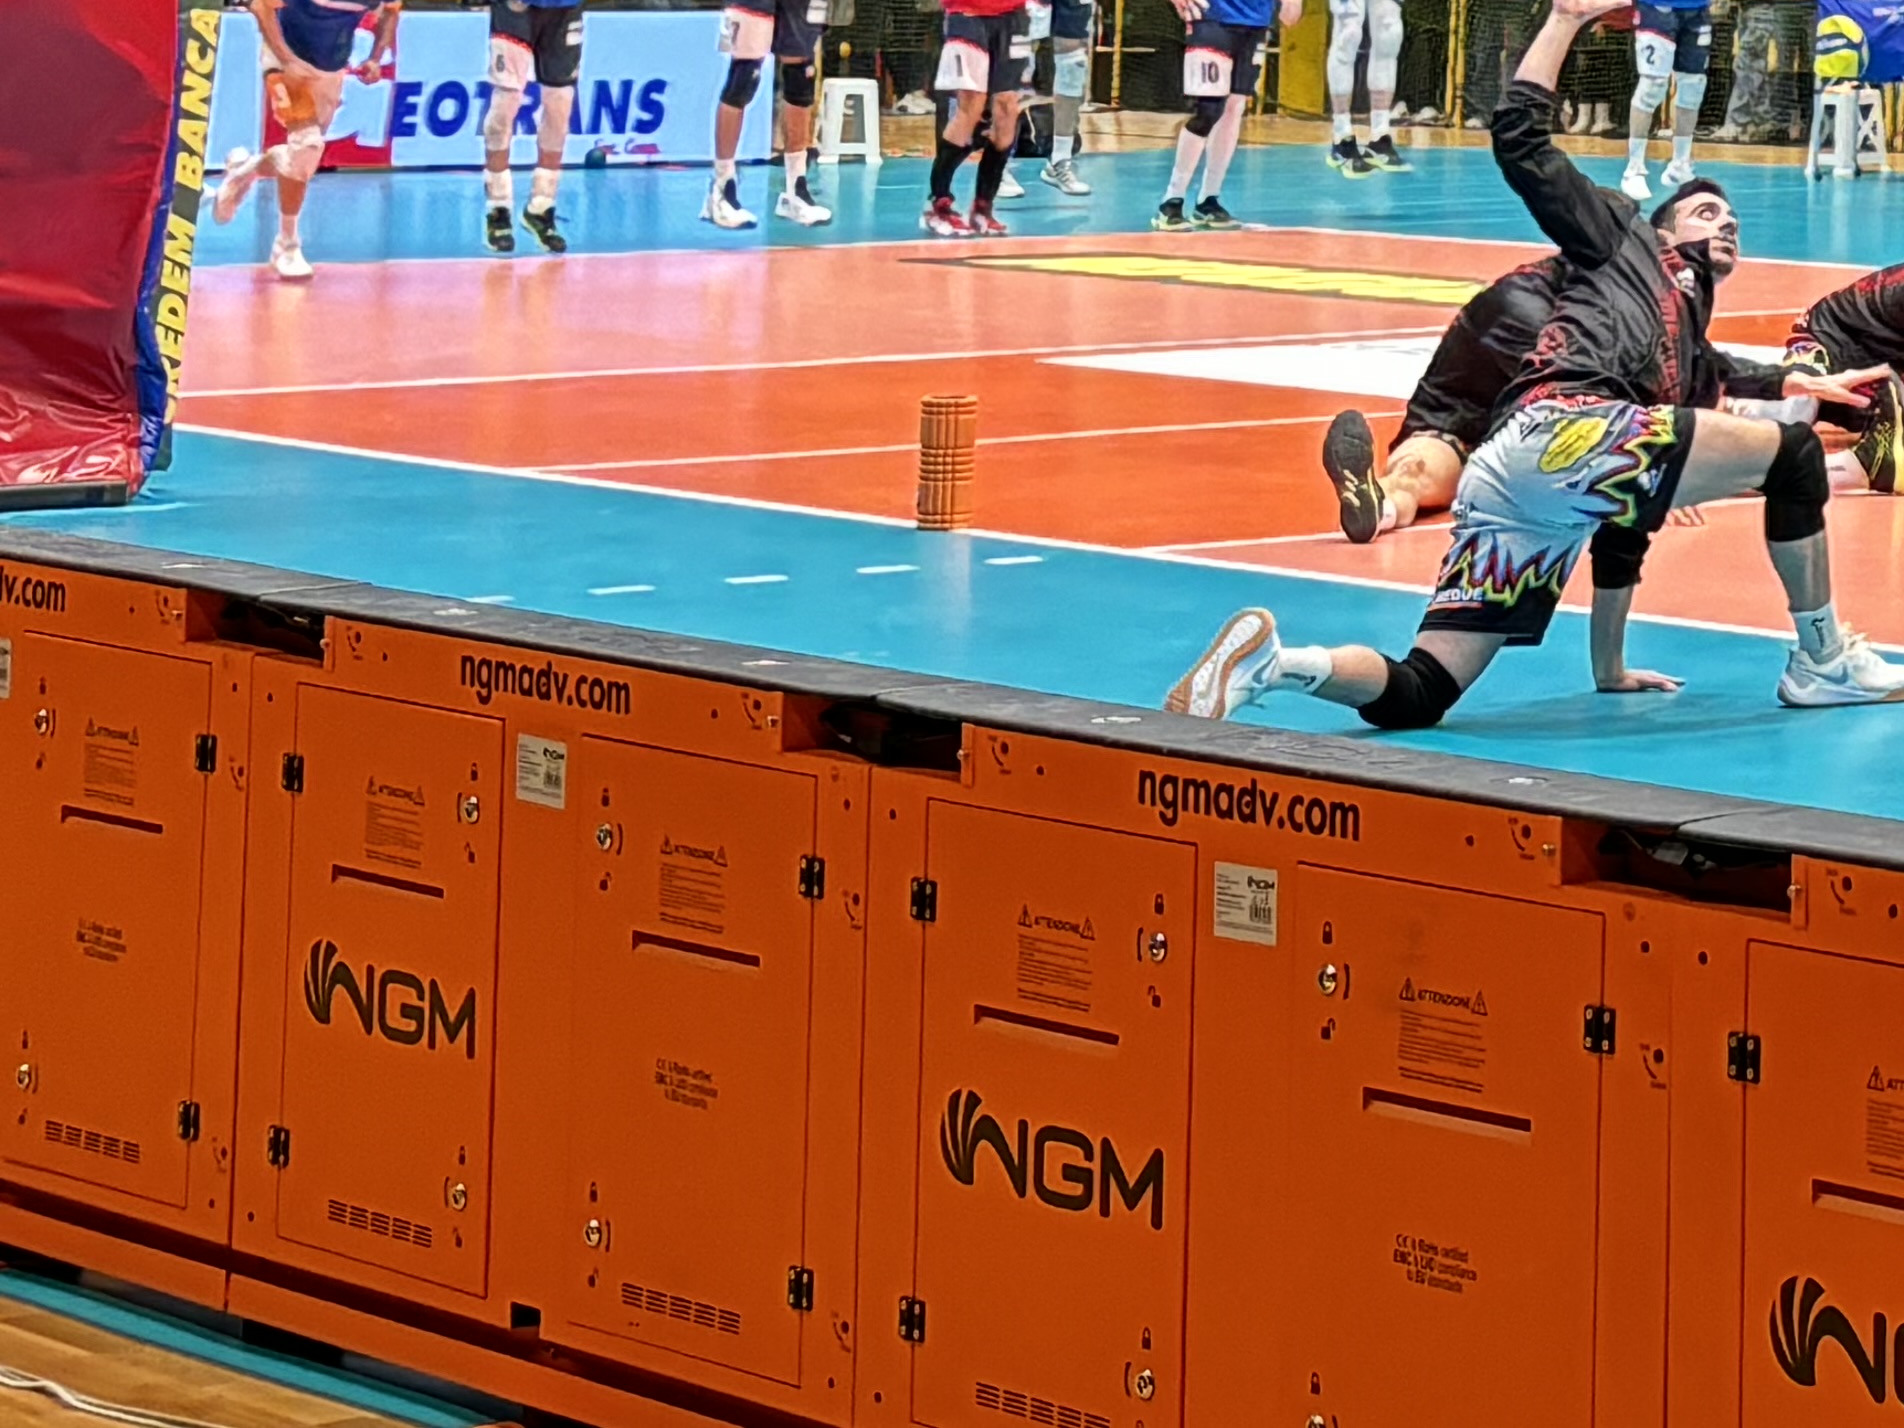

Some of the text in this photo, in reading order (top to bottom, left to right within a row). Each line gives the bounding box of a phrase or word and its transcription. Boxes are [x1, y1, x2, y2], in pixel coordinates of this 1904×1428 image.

[171, 7, 219, 197] BANCA
[1201, 61, 1219, 83] 10
[460, 651, 631, 716] ngmadv.com
[1138, 770, 1360, 842] ngmadv.com
[304, 938, 477, 1061] NGM
[940, 1087, 1165, 1231] NGM
